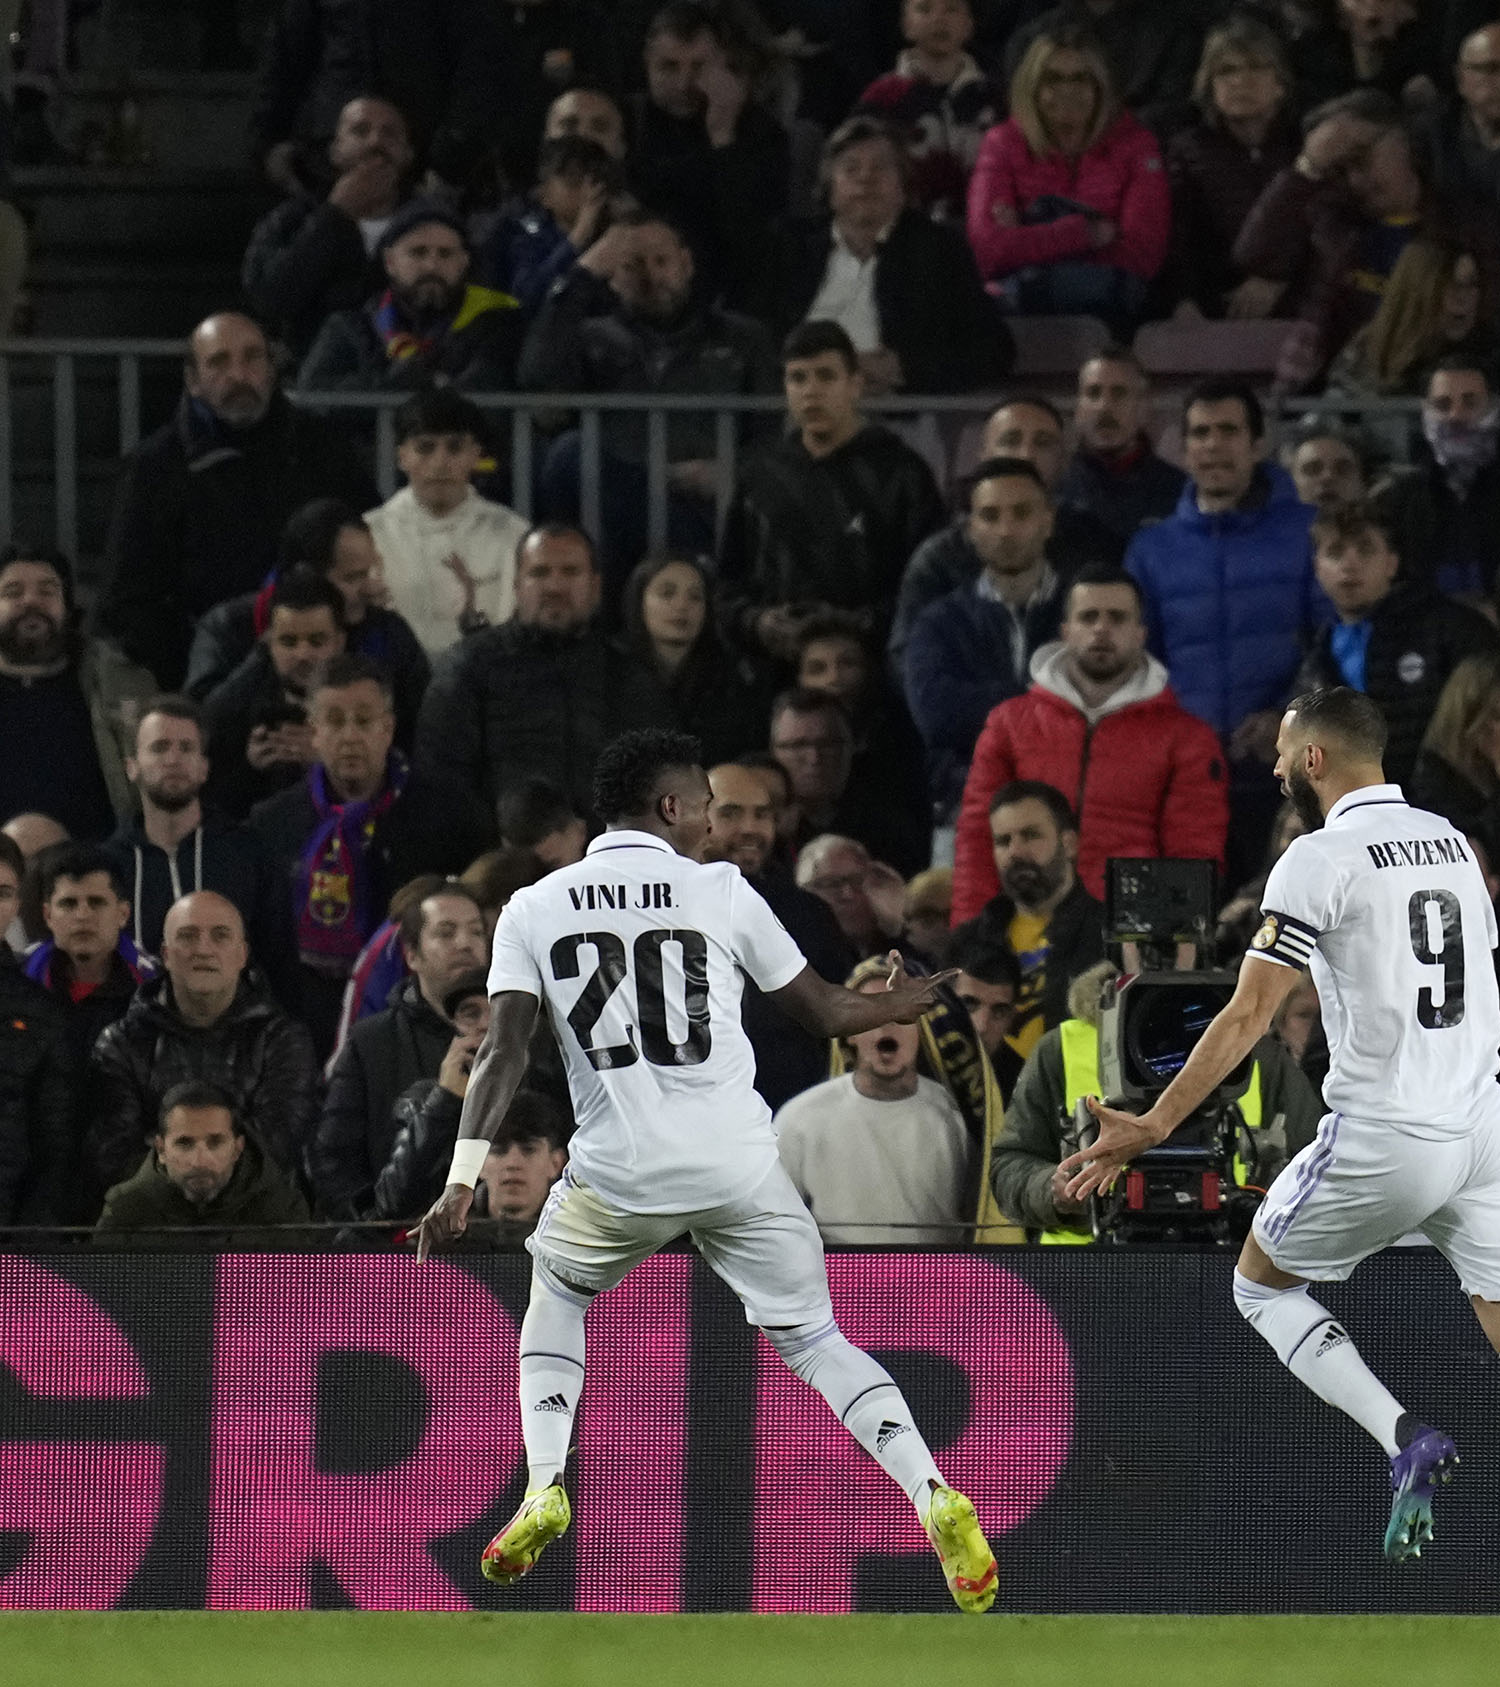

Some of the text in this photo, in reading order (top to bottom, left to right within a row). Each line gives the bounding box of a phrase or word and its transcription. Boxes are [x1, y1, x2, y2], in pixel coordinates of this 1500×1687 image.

[568, 882, 680, 911] VINI JR.
[1366, 837, 1469, 869] BENZEMA
[549, 929, 713, 1072] 20
[1408, 888, 1466, 1030] 9
